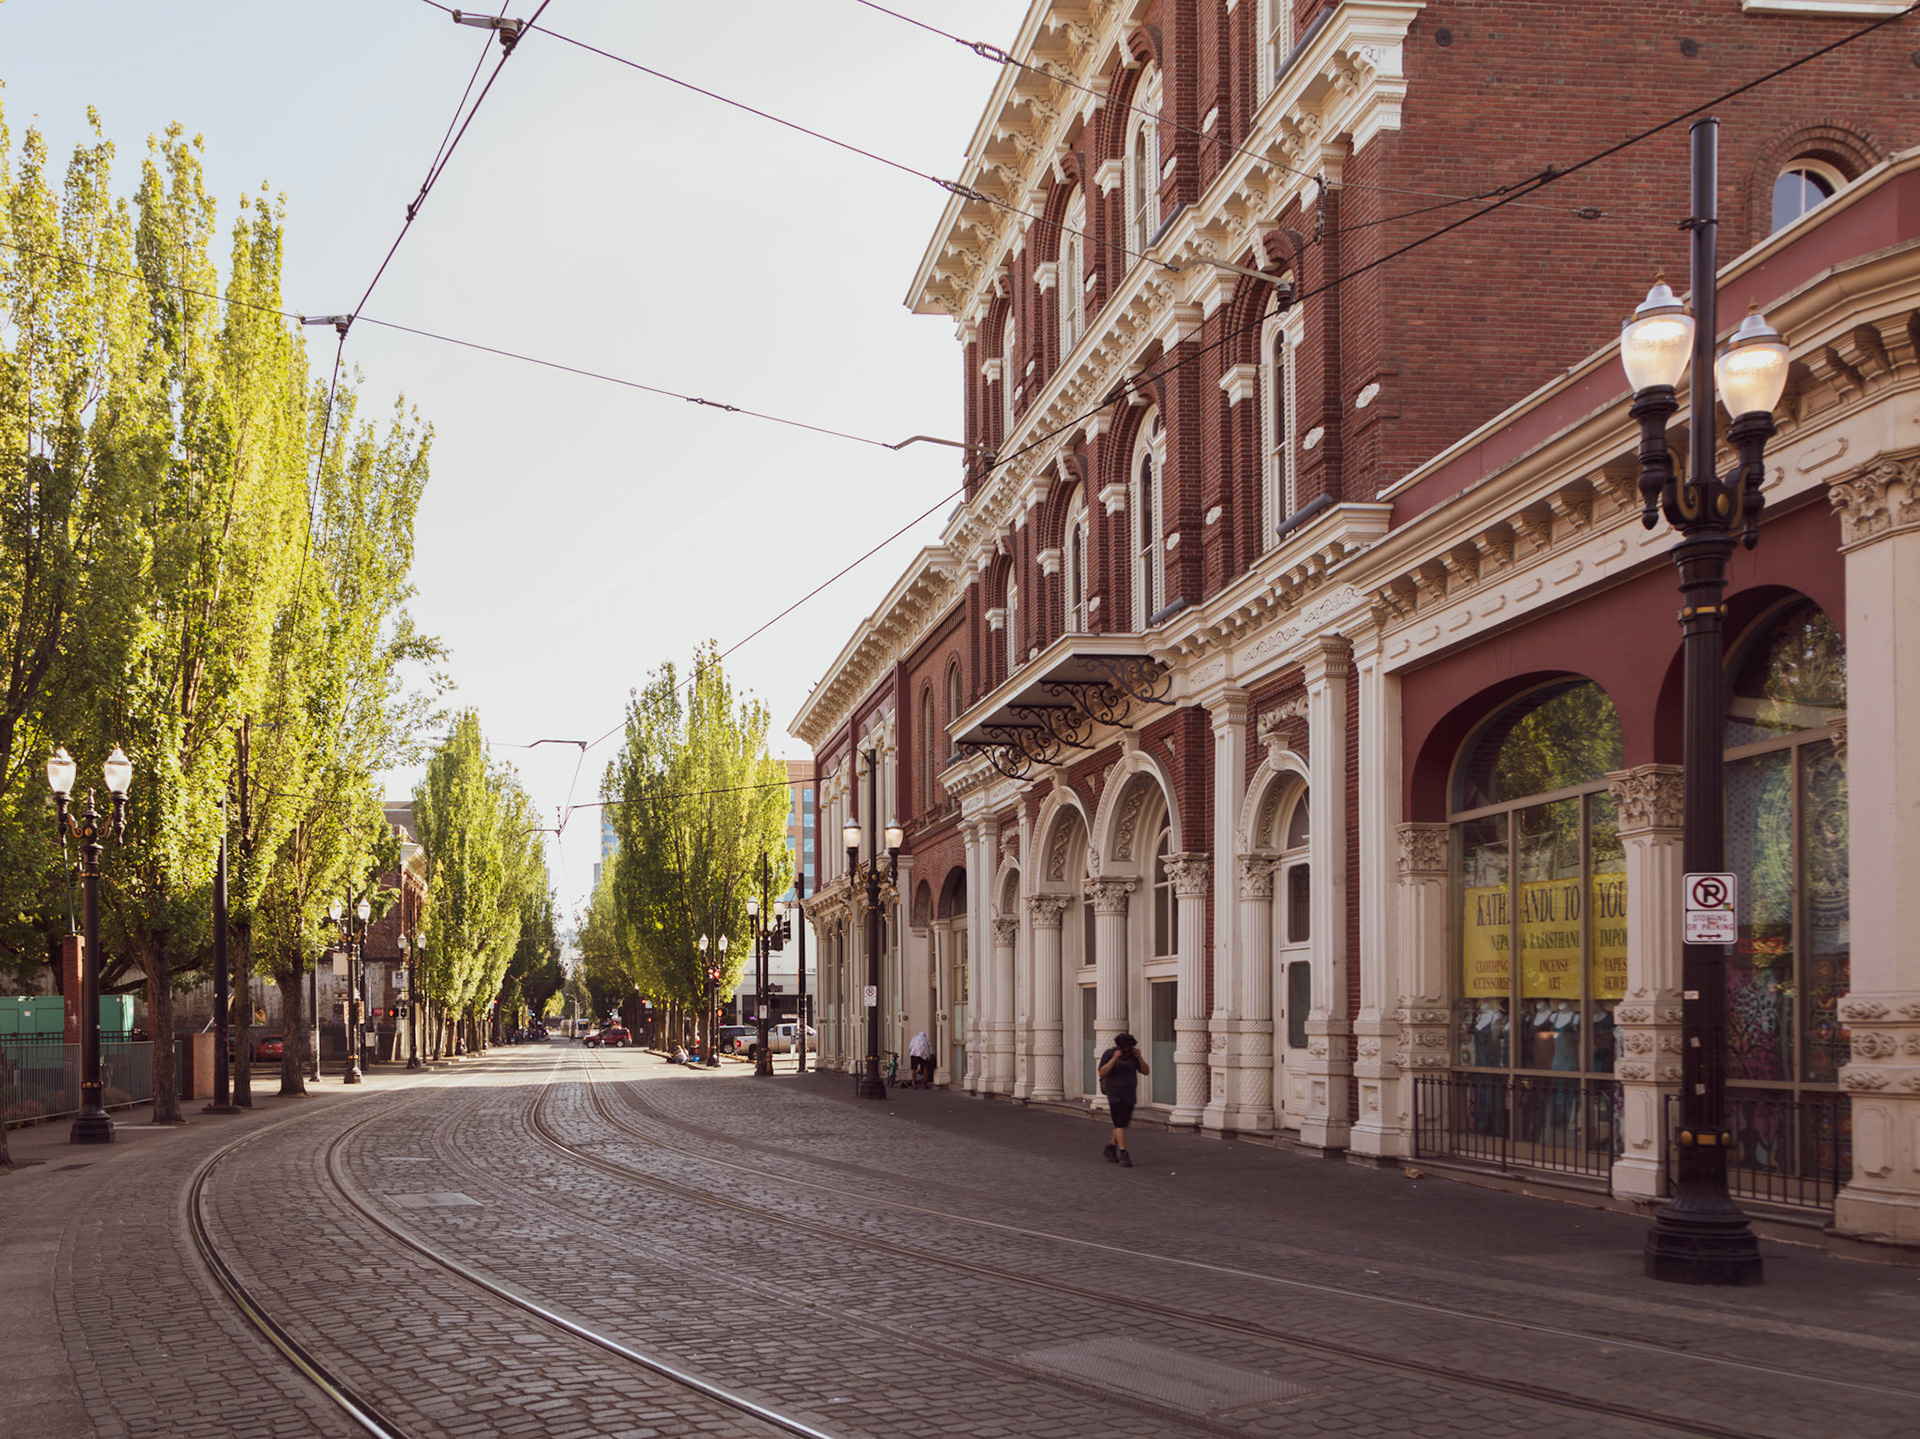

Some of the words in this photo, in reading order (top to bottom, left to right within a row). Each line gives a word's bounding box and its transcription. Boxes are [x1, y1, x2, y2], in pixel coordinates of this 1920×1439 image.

[1476, 888, 1558, 926] KATHANDU
[1563, 885, 1581, 921] TO
[1475, 959, 1509, 973] CLOTHING
[1539, 958, 1569, 972] INCENSE
[1548, 976, 1561, 990] ART
